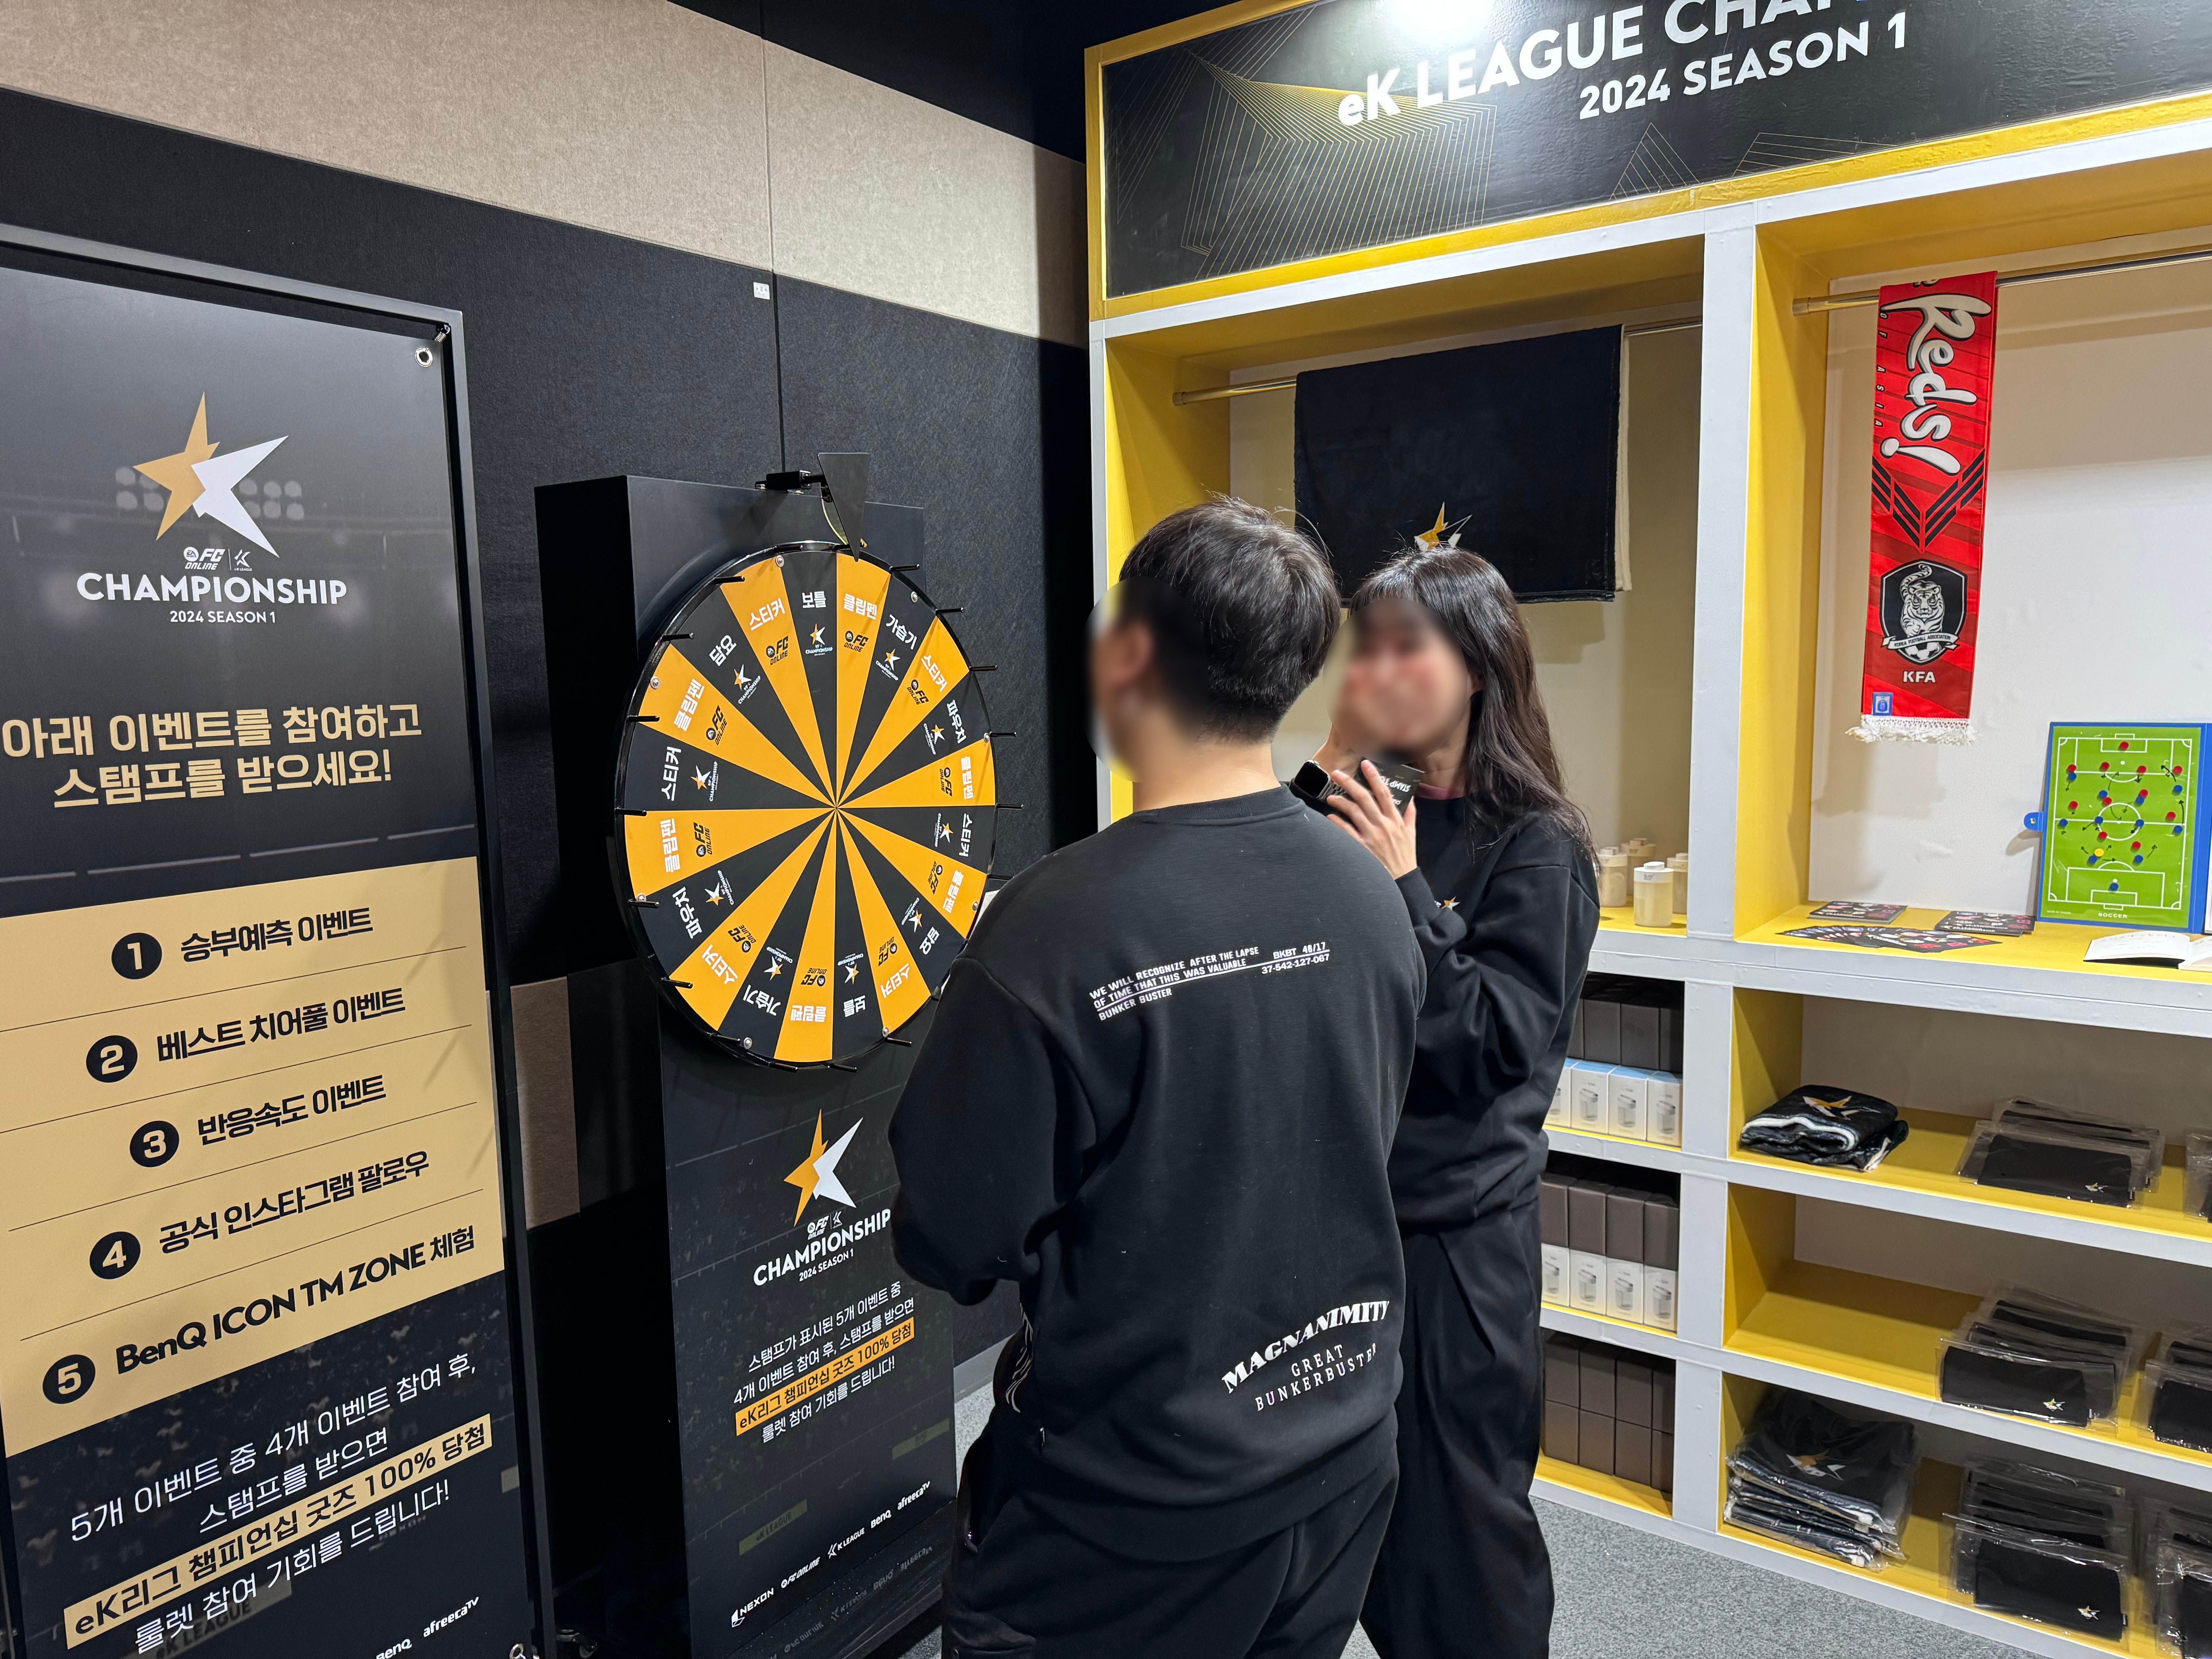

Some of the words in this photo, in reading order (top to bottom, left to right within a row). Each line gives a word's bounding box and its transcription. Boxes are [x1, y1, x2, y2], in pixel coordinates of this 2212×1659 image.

[1338, 67, 1401, 127] eK
[1417, 5, 1644, 109] LEAGUE
[1579, 68, 1670, 120] 2024
[1683, 21, 1869, 95] SEASON
[1888, 12, 1905, 48] 1
[199, 548, 225, 562] FC
[77, 573, 346, 604] CHAMPIONSHIP
[802, 591, 826, 608] 보틀
[843, 593, 877, 620] 클립펜
[170, 611, 204, 622] 2024
[208, 611, 266, 623] SEASON
[270, 612, 275, 623] 1
[749, 598, 785, 631] 스티커
[886, 614, 917, 650] 가습기
[709, 635, 737, 666] 담요
[776, 636, 788, 654] FC
[853, 634, 869, 647] FC
[921, 655, 948, 692] 스티커
[1903, 671, 1936, 683] KFA
[674, 678, 705, 731] 클립펜
[915, 690, 929, 704] FC
[2, 716, 93, 758] 아래
[110, 709, 271, 752] 이벤트를
[283, 704, 421, 743] 참여하고
[712, 705, 724, 730] FC
[946, 699, 966, 744] 파우치
[55, 759, 225, 807] 스탬프를
[237, 749, 391, 793] 받으세요!
[661, 746, 682, 801] 스티커
[944, 779, 952, 797] FC
[960, 756, 974, 800] 클립펜
[660, 818, 680, 873] 클립펜
[694, 822, 705, 843] FC
[959, 813, 972, 857] 스티커
[930, 875, 939, 895] FC
[943, 870, 964, 914] 클립펜
[672, 886, 703, 939] 파우치
[128, 943, 142, 969] 1
[181, 920, 293, 962] 승부예측
[298, 908, 373, 941] 이벤트
[728, 929, 745, 943] FC
[919, 926, 939, 955] 담요
[1273, 948, 1297, 960] BKBT
[701, 944, 738, 985] 스티커
[878, 952, 889, 966] FC
[1089, 986, 1107, 999] WE
[1108, 976, 1134, 991] WILL
[1136, 961, 1185, 980] RECOGNIZE
[1190, 955, 1217, 967] AFTER
[1218, 951, 1233, 961] THE
[1235, 947, 1259, 958] LAPSE
[1262, 953, 1329, 975] 37-542-127-067
[800, 974, 817, 985] FC
[880, 963, 910, 998] 스티커
[1093, 997, 1106, 1009] OF
[1108, 986, 1133, 1001] TIME
[1133, 978, 1157, 991] THAT
[1159, 973, 1180, 984] THIS
[1183, 967, 1206, 978] WAS
[1207, 958, 1246, 973] VALUABLE
[743, 984, 782, 1016] 가습기
[790, 1005, 826, 1022] 클립펜
[843, 995, 866, 1017] 보틀
[1099, 999, 1136, 1021] BUNKER
[1139, 988, 1172, 1004] BUSTER
[101, 1045, 128, 1077] 2
[157, 1020, 245, 1061] 베스트
[250, 1003, 328, 1042] 치어풀
[333, 988, 405, 1023] 이벤트
[143, 1130, 166, 1158] 3
[198, 1094, 308, 1146] 반응속도
[313, 1075, 386, 1114] 이벤트
[103, 1240, 126, 1268] 4
[160, 1212, 218, 1254] 공식
[224, 1171, 354, 1234] 인스타그램
[358, 1151, 429, 1193] 팔로우
[754, 1209, 891, 1286] CHAMPIONSHIP
[799, 1267, 817, 1282] 2024
[818, 1252, 849, 1273] SEASON
[850, 1248, 854, 1257] 1
[58, 1363, 81, 1394] 5
[116, 1322, 207, 1374] BenQ
[213, 1288, 295, 1340] ICON
[300, 1271, 343, 1306] TM
[349, 1242, 426, 1291] ZONE
[430, 1225, 474, 1261] 체험
[748, 1335, 797, 1372] 스탬프가
[799, 1316, 833, 1347] 표시된
[836, 1305, 855, 1326] 5개
[857, 1288, 888, 1315] 이벤트
[891, 1281, 901, 1298] 중
[733, 1382, 755, 1404] 4개
[759, 1360, 794, 1392] 이벤트
[797, 1348, 820, 1372] 참여
[823, 1342, 836, 1358] 후,
[840, 1314, 882, 1350] 스탬프를
[884, 1297, 914, 1325] 받으면
[1221, 1300, 1390, 1394] MAGNANIMITY
[1291, 1344, 1343, 1377] GREAT
[740, 1396, 781, 1428] eK리그
[784, 1368, 829, 1405] 챔피언십
[833, 1355, 855, 1379] 굿즈
[858, 1337, 889, 1363] 100%
[892, 1322, 911, 1345] 당첨
[1255, 1343, 1376, 1412] BUNKERBUSTER
[762, 1416, 786, 1444] 룰렛
[790, 1402, 812, 1427] 참여
[815, 1382, 848, 1413] 기회를
[851, 1355, 895, 1393] 드립니다!
[72, 1498, 123, 1541] 5개
[135, 1458, 222, 1512] 이벤트
[230, 1443, 256, 1474] 중
[266, 1424, 308, 1455] 4개
[318, 1393, 390, 1434] 이벤트
[397, 1364, 440, 1402] 참여
[449, 1352, 475, 1378] 후,
[200, 1463, 307, 1533] 스탬프를
[316, 1427, 387, 1478] 받으면
[897, 1481, 930, 1510] afreecaTV
[76, 1570, 181, 1634] eK리그
[189, 1514, 300, 1582] 챔피언십
[307, 1485, 356, 1527] 굿즈
[365, 1451, 437, 1496] 100%
[443, 1425, 484, 1461] 당첨
[843, 1527, 865, 1547] LEAGUE
[871, 1510, 891, 1528] BenQ
[136, 1605, 194, 1654] 룰렛
[203, 1573, 256, 1620] 참여
[269, 1532, 342, 1588] 기회를
[351, 1479, 448, 1547] 드립니다!
[423, 1596, 479, 1637] afreecaTV
[740, 1587, 774, 1616] NEXON
